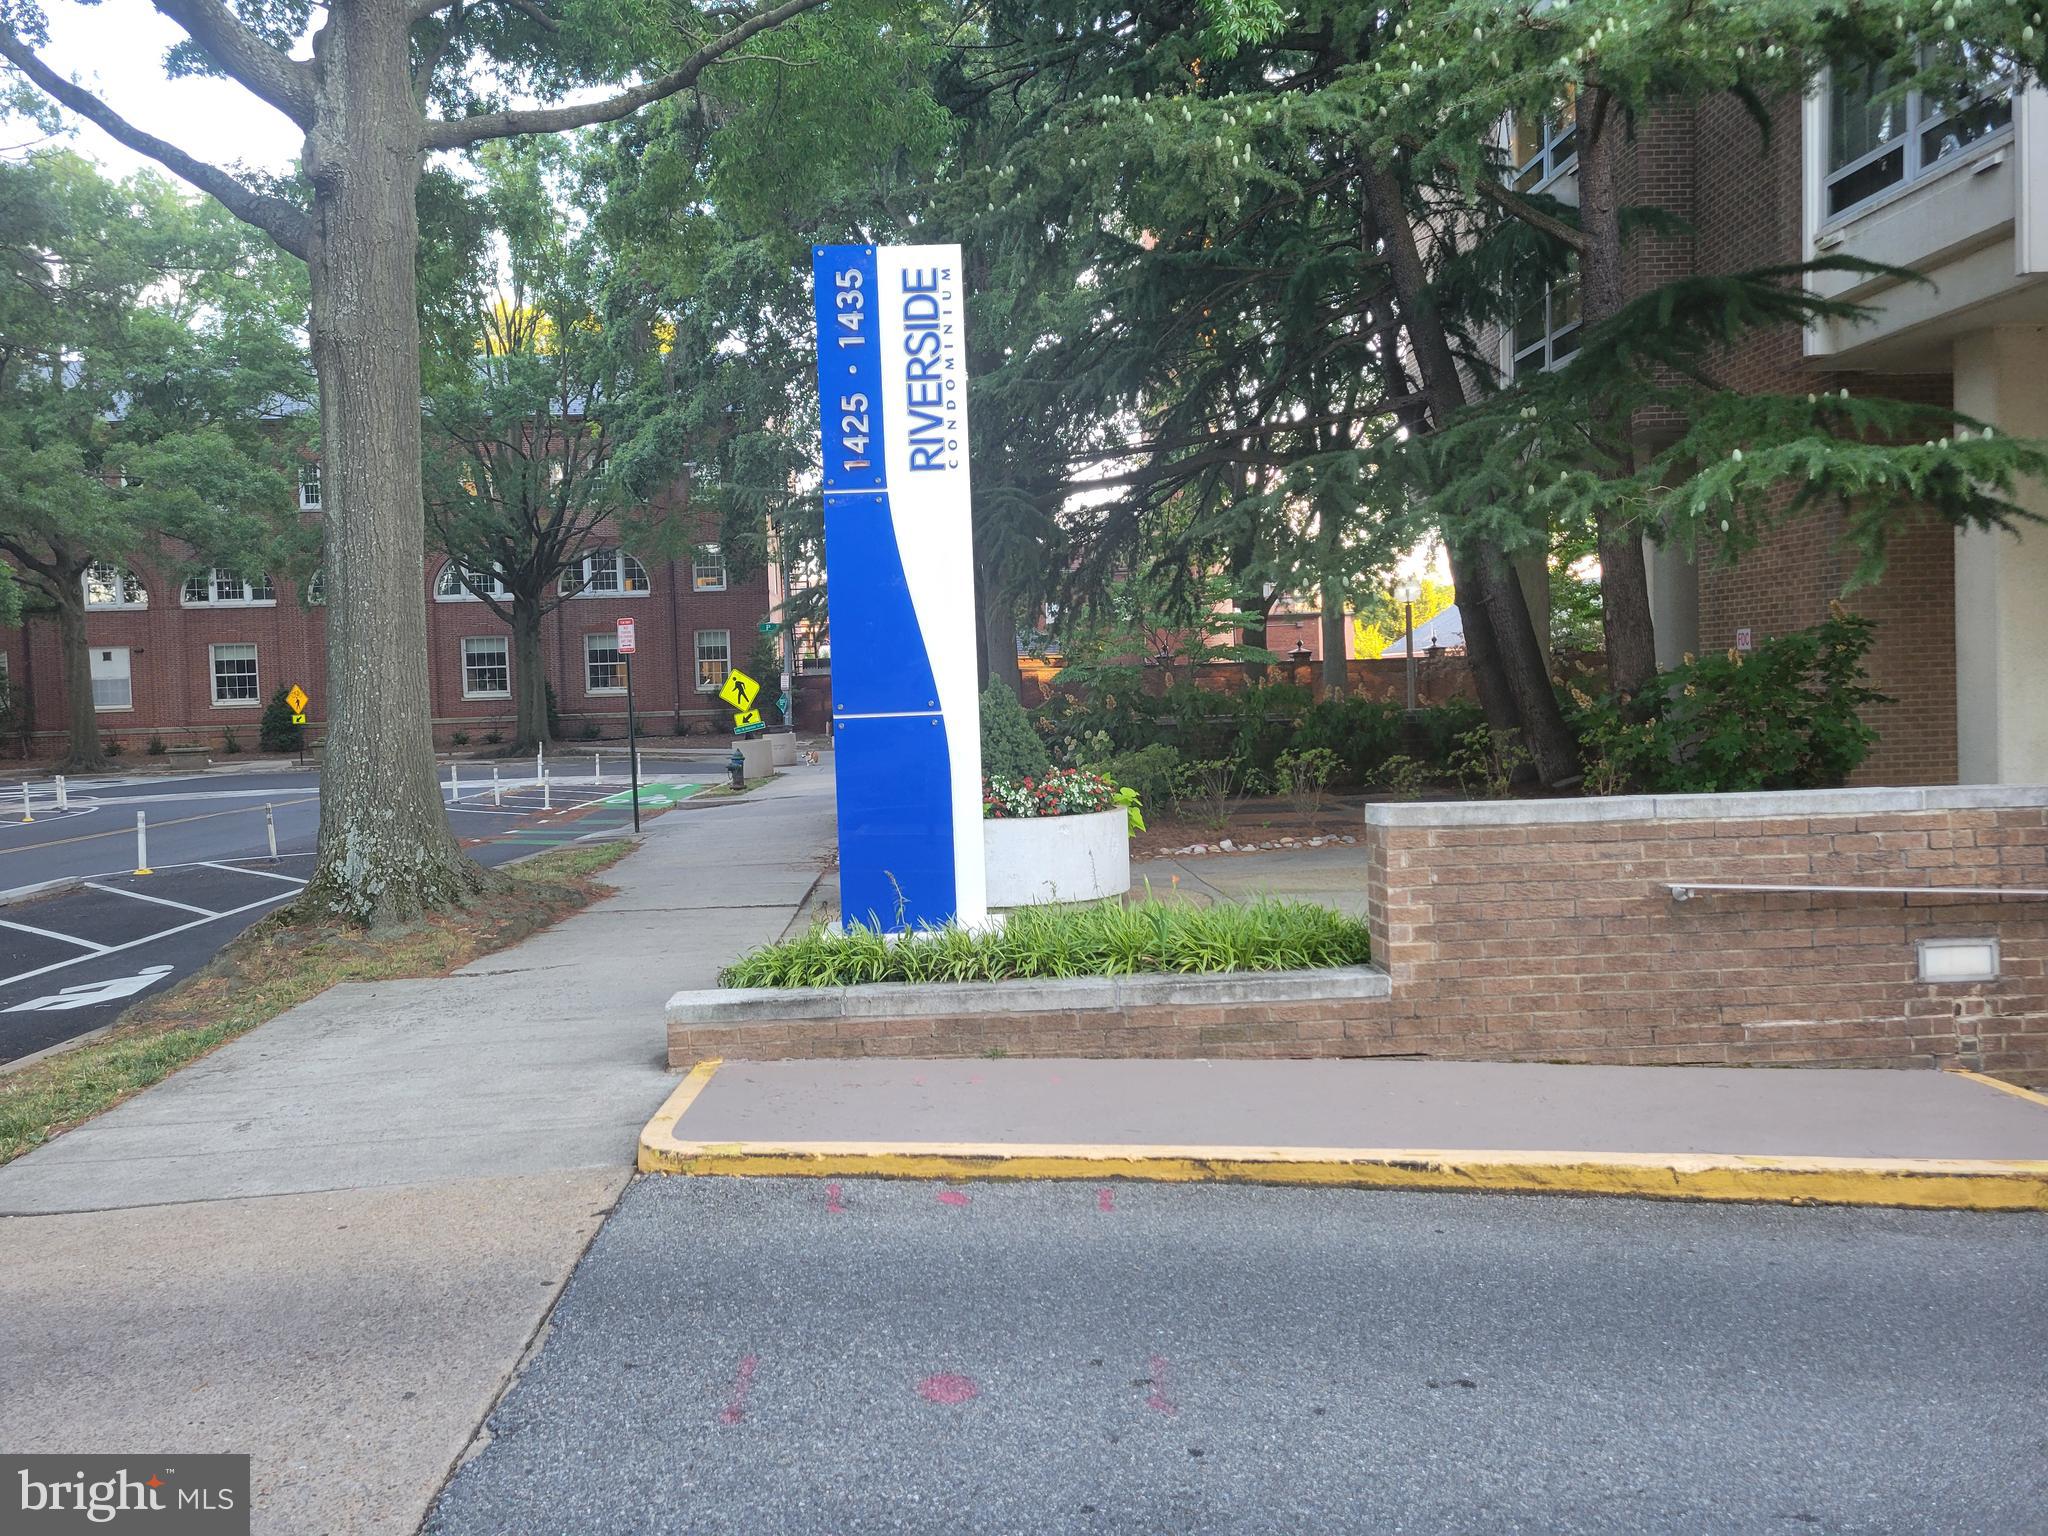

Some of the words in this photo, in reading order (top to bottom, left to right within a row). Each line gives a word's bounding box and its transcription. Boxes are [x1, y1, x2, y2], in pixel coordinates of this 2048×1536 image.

[835, 268, 866, 349] 1435
[901, 267, 946, 472] RIVERSIDE
[941, 268, 958, 469] CONDOMINIUM
[840, 392, 871, 472] 1425
